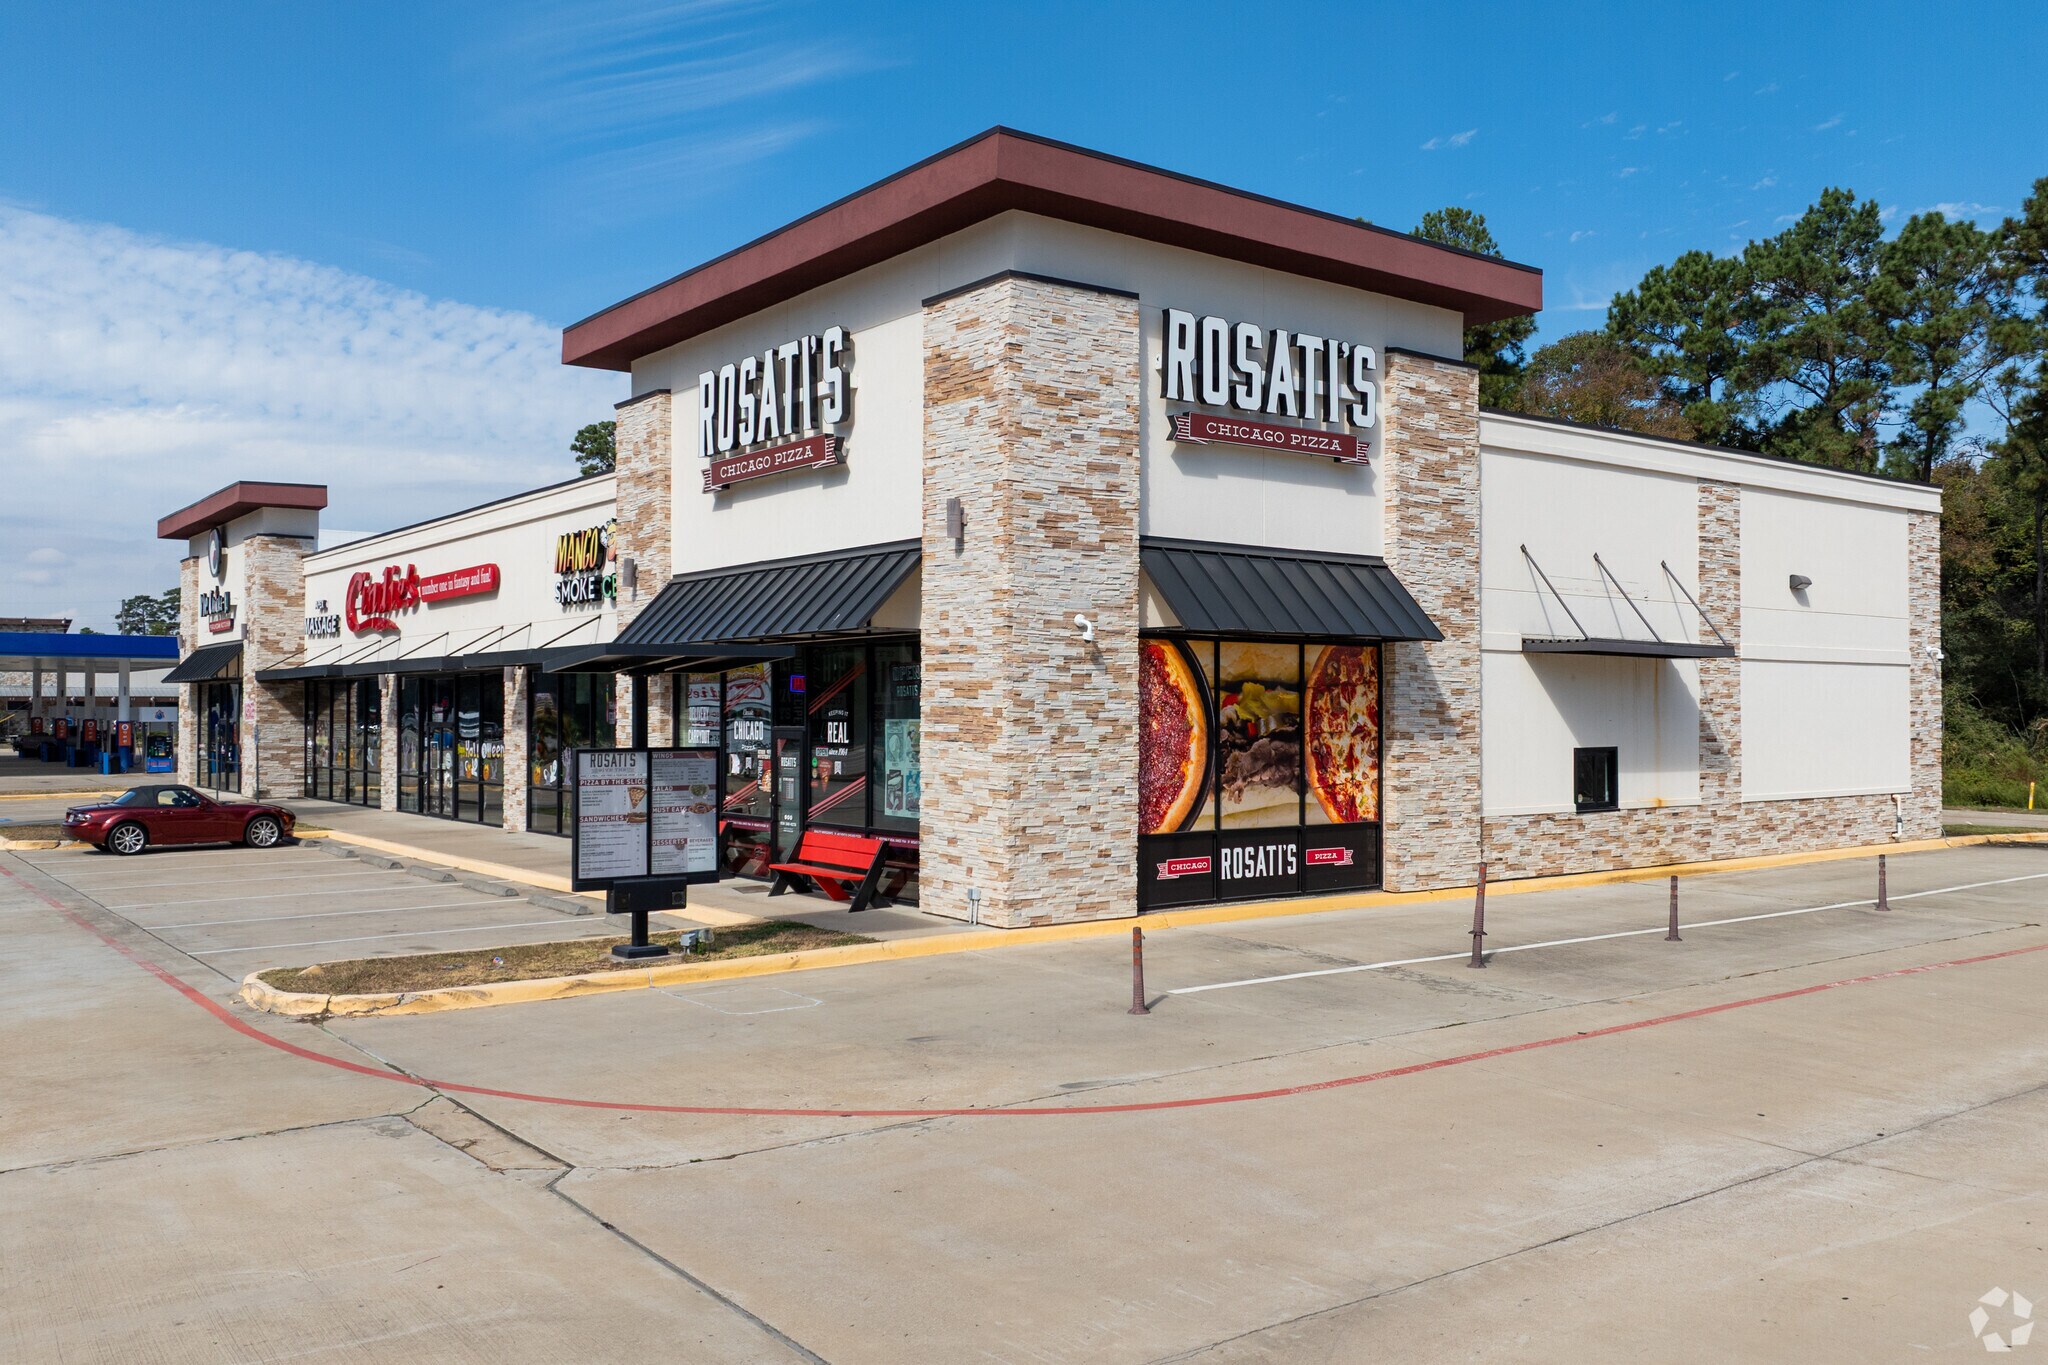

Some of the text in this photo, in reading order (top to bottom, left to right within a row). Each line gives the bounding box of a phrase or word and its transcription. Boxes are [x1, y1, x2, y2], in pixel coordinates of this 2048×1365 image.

[1160, 308, 1376, 428] ROSATI'S
[698, 325, 850, 458] ROSATI'S
[1206, 422, 1342, 451] CHICAGO PIZZA
[720, 445, 813, 478] CHICAGO PIZZA
[554, 528, 599, 574] MANGO
[421, 580, 439, 595] number
[448, 576, 453, 590] in
[454, 573, 470, 591] fantasy
[471, 569, 480, 586] and
[481, 567, 491, 584] fun!
[555, 576, 597, 603] SMOKE
[733, 720, 764, 740] CHICAGO
[827, 721, 850, 743] REAL
[590, 753, 636, 768] ROSATI'S
[580, 814, 624, 822] SANDWICHES
[652, 838, 685, 846] DESSERTS
[1170, 843, 1338, 880] CHICAGO ROSATI'S PIZZA
